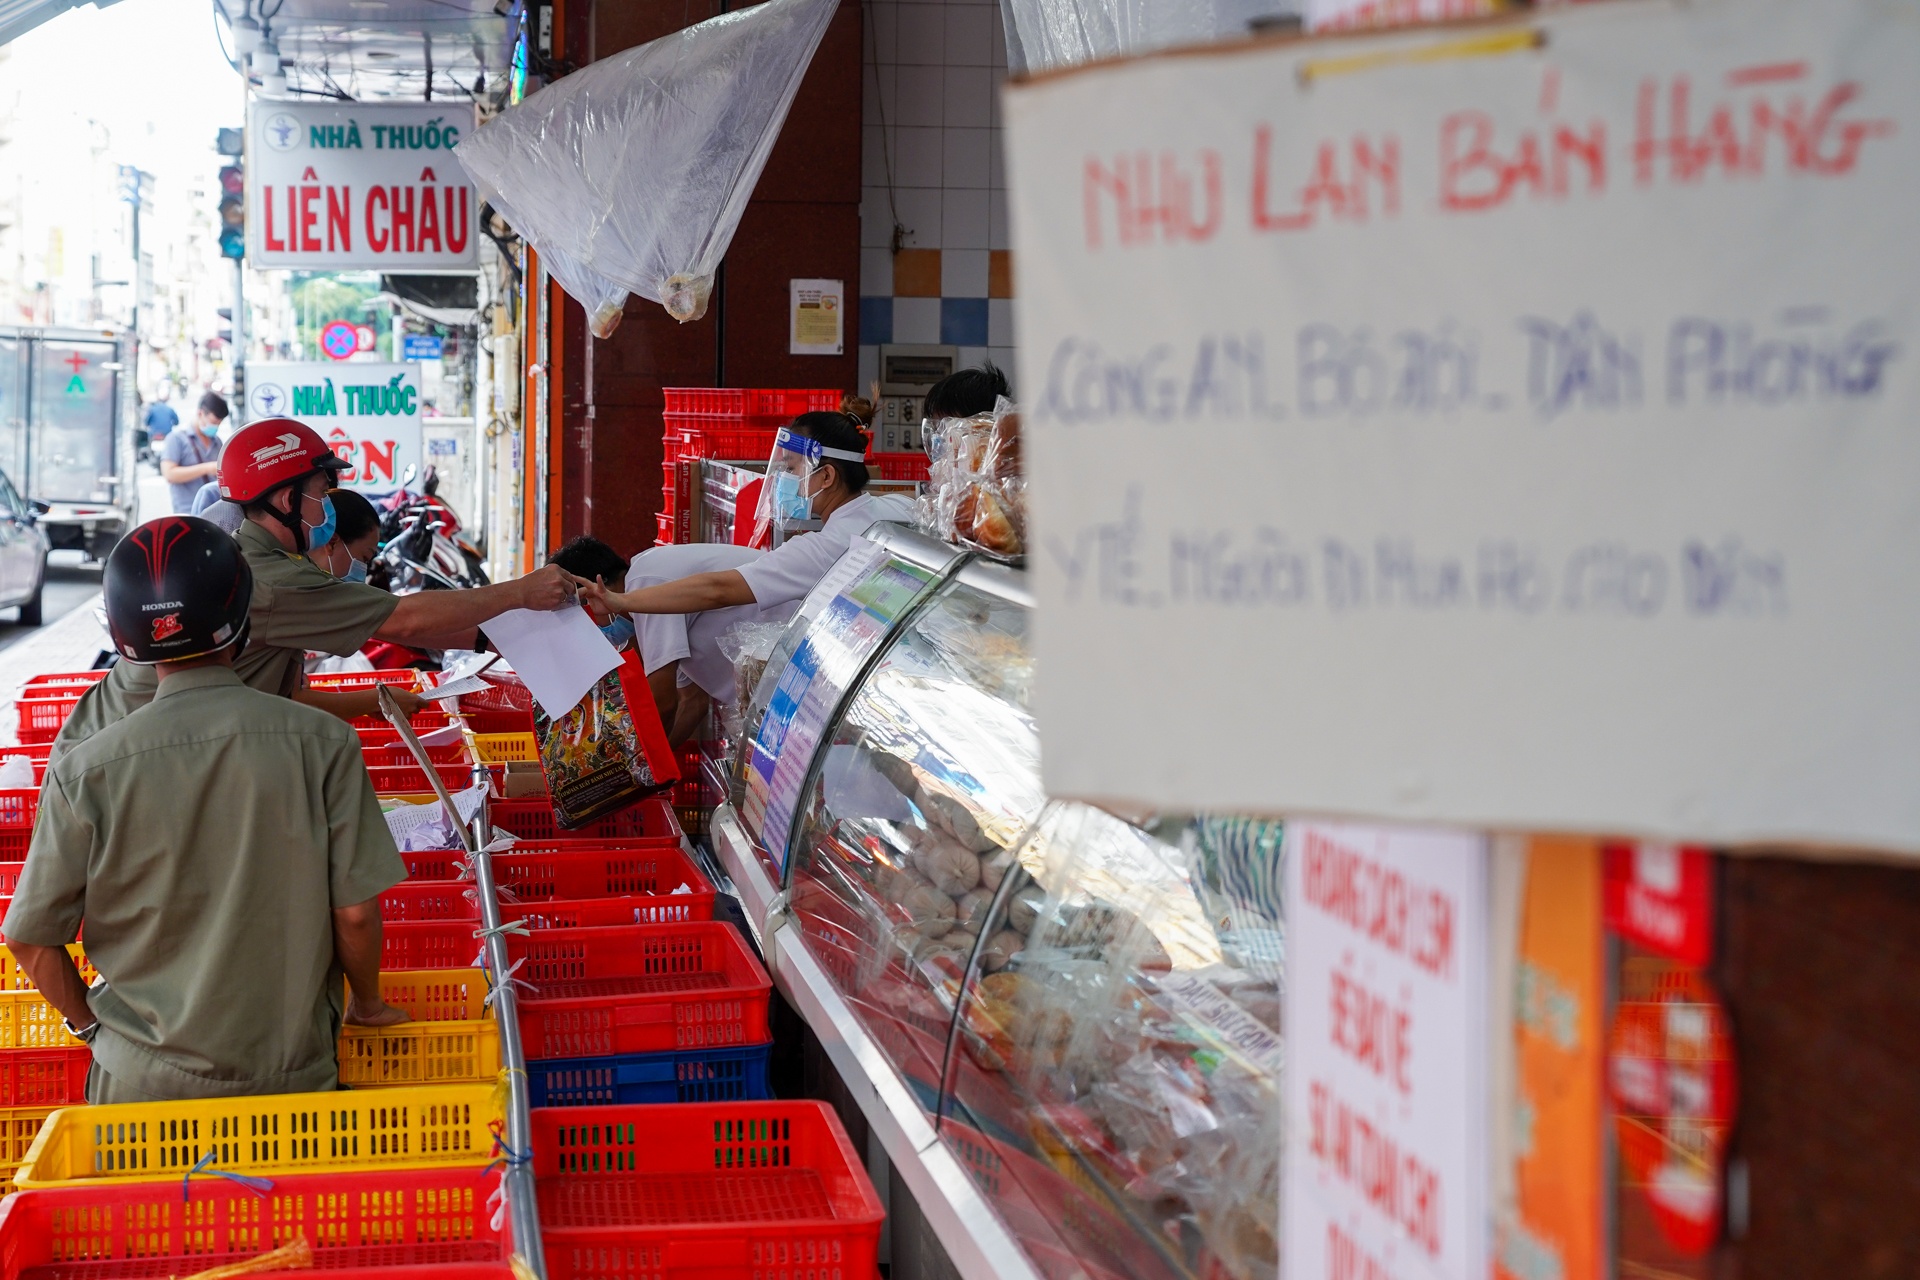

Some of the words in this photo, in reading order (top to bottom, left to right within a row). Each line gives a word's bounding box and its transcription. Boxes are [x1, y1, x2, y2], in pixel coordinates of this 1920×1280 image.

[309, 118, 362, 149] NHÀ
[371, 116, 459, 150] THUỐC
[1248, 118, 1404, 234] LAN
[263, 166, 351, 252] LIÊN
[365, 166, 468, 254] CHÂU
[292, 377, 338, 416] NHÀ
[343, 372, 417, 416] THUỐC
[257, 458, 279, 471] Honda
[280, 449, 308, 462] Visacoop
[682, 509, 690, 528] Như
[141, 601, 184, 611] HONDA
